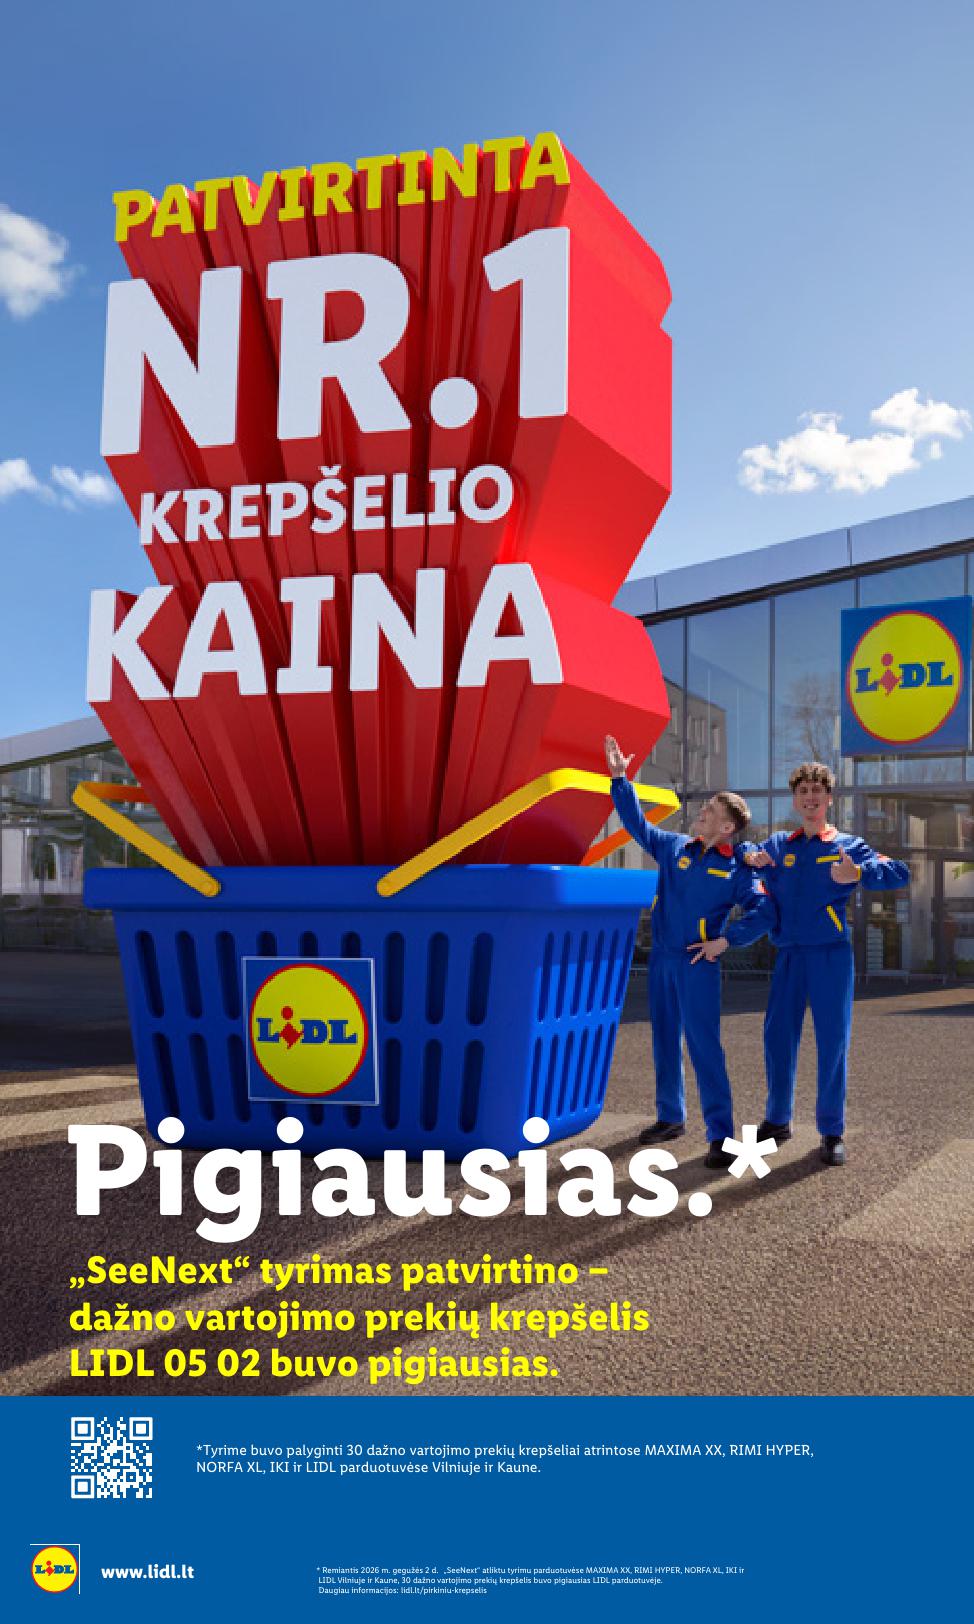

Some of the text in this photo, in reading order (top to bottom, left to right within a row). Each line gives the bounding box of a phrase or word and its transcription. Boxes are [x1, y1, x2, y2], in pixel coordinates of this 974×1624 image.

[112, 131, 571, 243] PATVIRTINTA
[100, 226, 571, 457] NR.1
[139, 463, 514, 546] KREPŠELIO
[86, 562, 564, 704] KAINA
